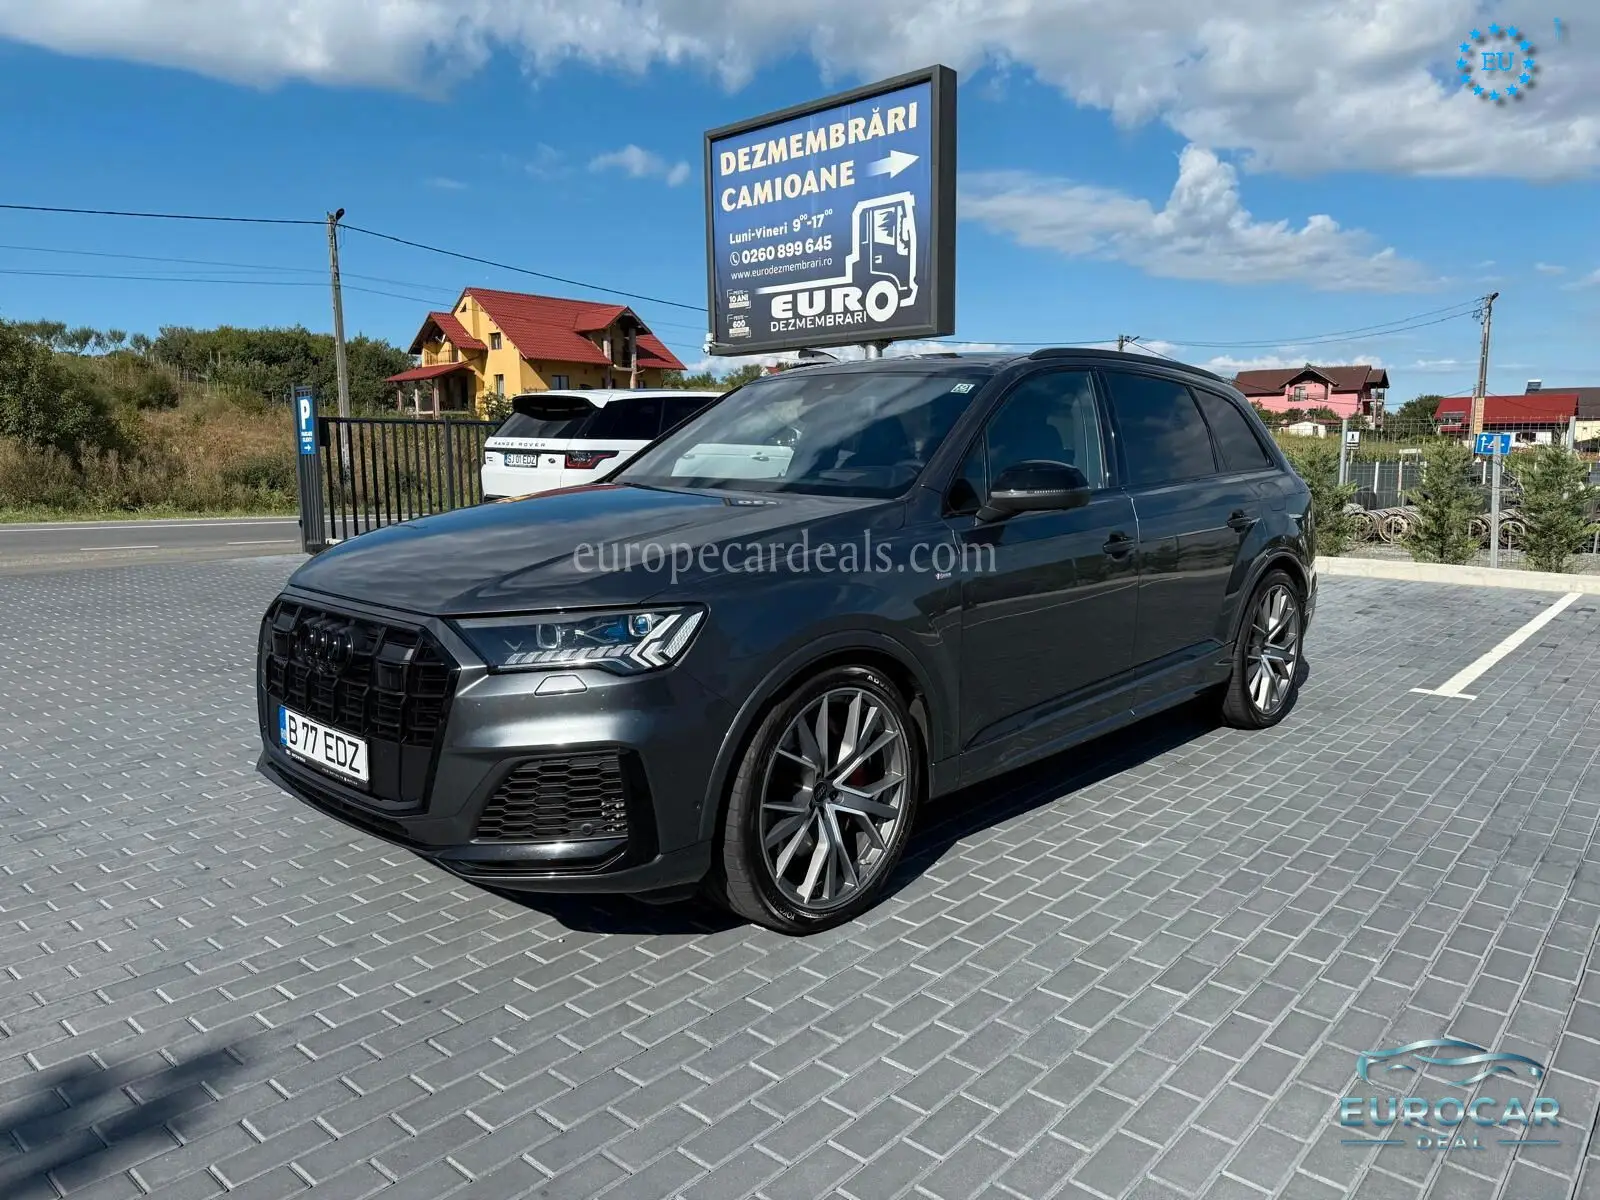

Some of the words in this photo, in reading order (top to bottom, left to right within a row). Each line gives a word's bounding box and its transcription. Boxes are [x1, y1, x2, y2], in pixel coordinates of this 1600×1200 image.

[721, 102, 917, 176] DEZMEMBRĂRI
[721, 160, 855, 212] CAMIOANE
[729, 222, 788, 244] Luni-Vineri
[741, 246, 775, 264] 0260
[777, 241, 803, 258] 899
[805, 234, 832, 254] 645
[730, 257, 833, 280] www.eurodezmembrari.ro
[771, 280, 899, 322] EURO
[770, 311, 867, 332] DEZMEMBRARI
[300, 399, 310, 430] P
[507, 454, 515, 464] SJ
[522, 454, 536, 465] EDZ
[288, 714, 298, 746] B
[302, 722, 318, 754] 77
[324, 731, 361, 774] EDZ
